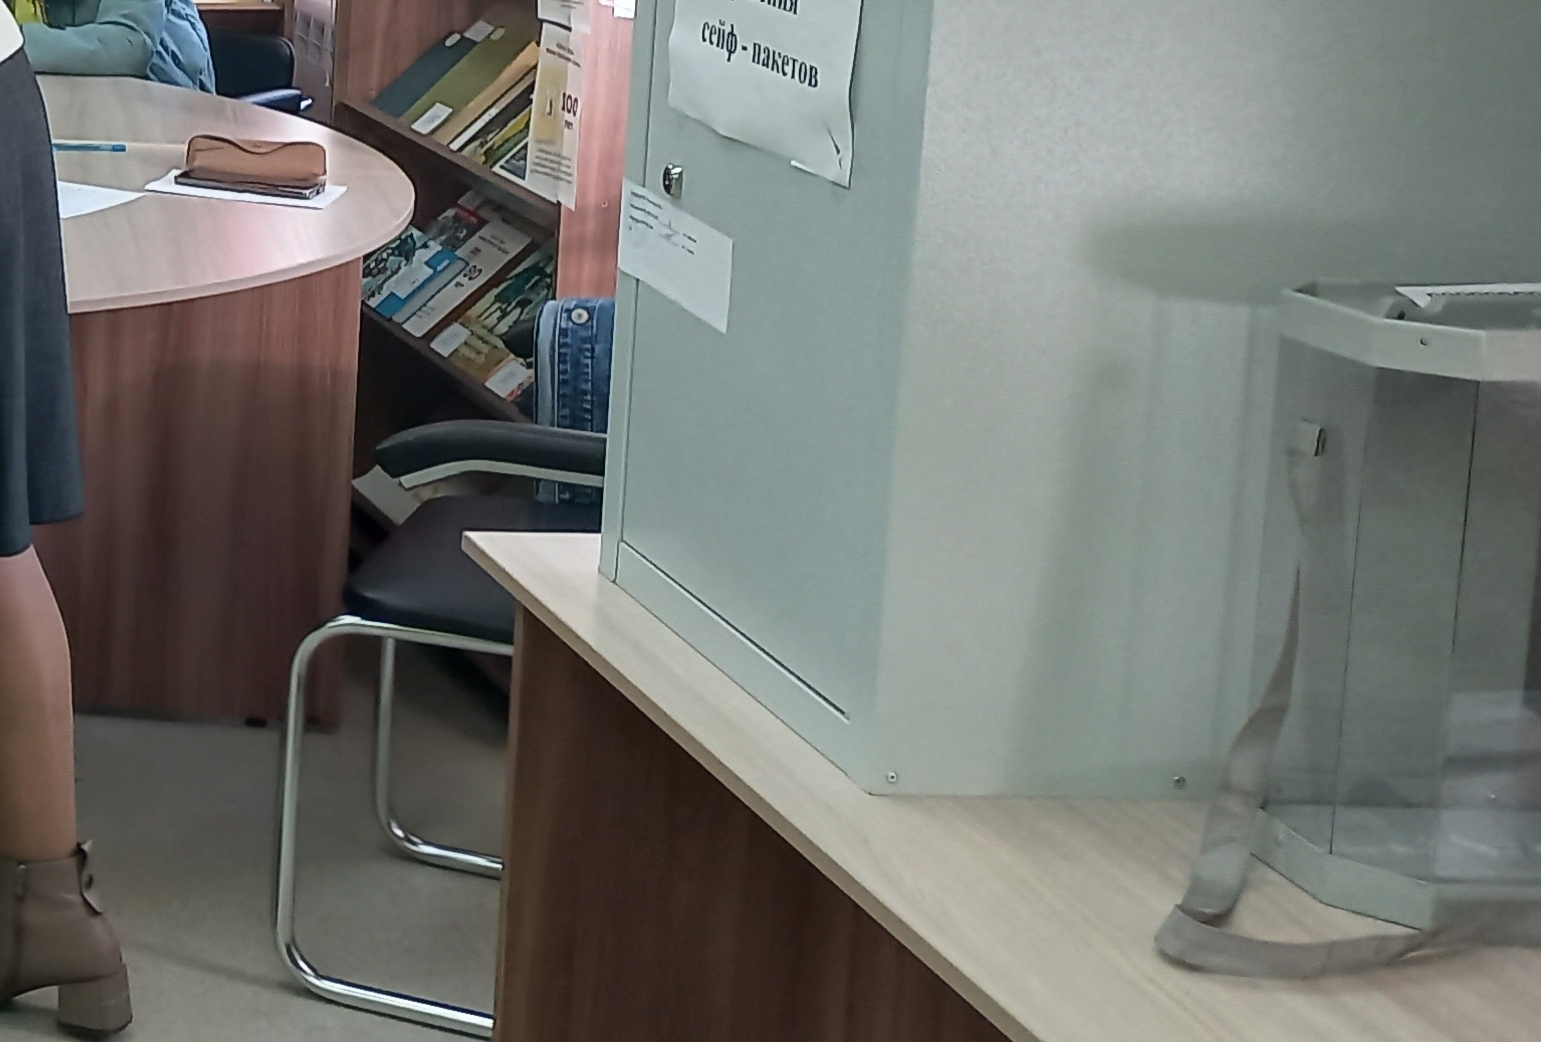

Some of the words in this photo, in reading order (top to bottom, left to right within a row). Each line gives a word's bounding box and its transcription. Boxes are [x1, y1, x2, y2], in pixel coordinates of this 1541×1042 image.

[701, 18, 737, 64] сейф
[751, 41, 819, 90] пакетов
[561, 91, 579, 116] 100
